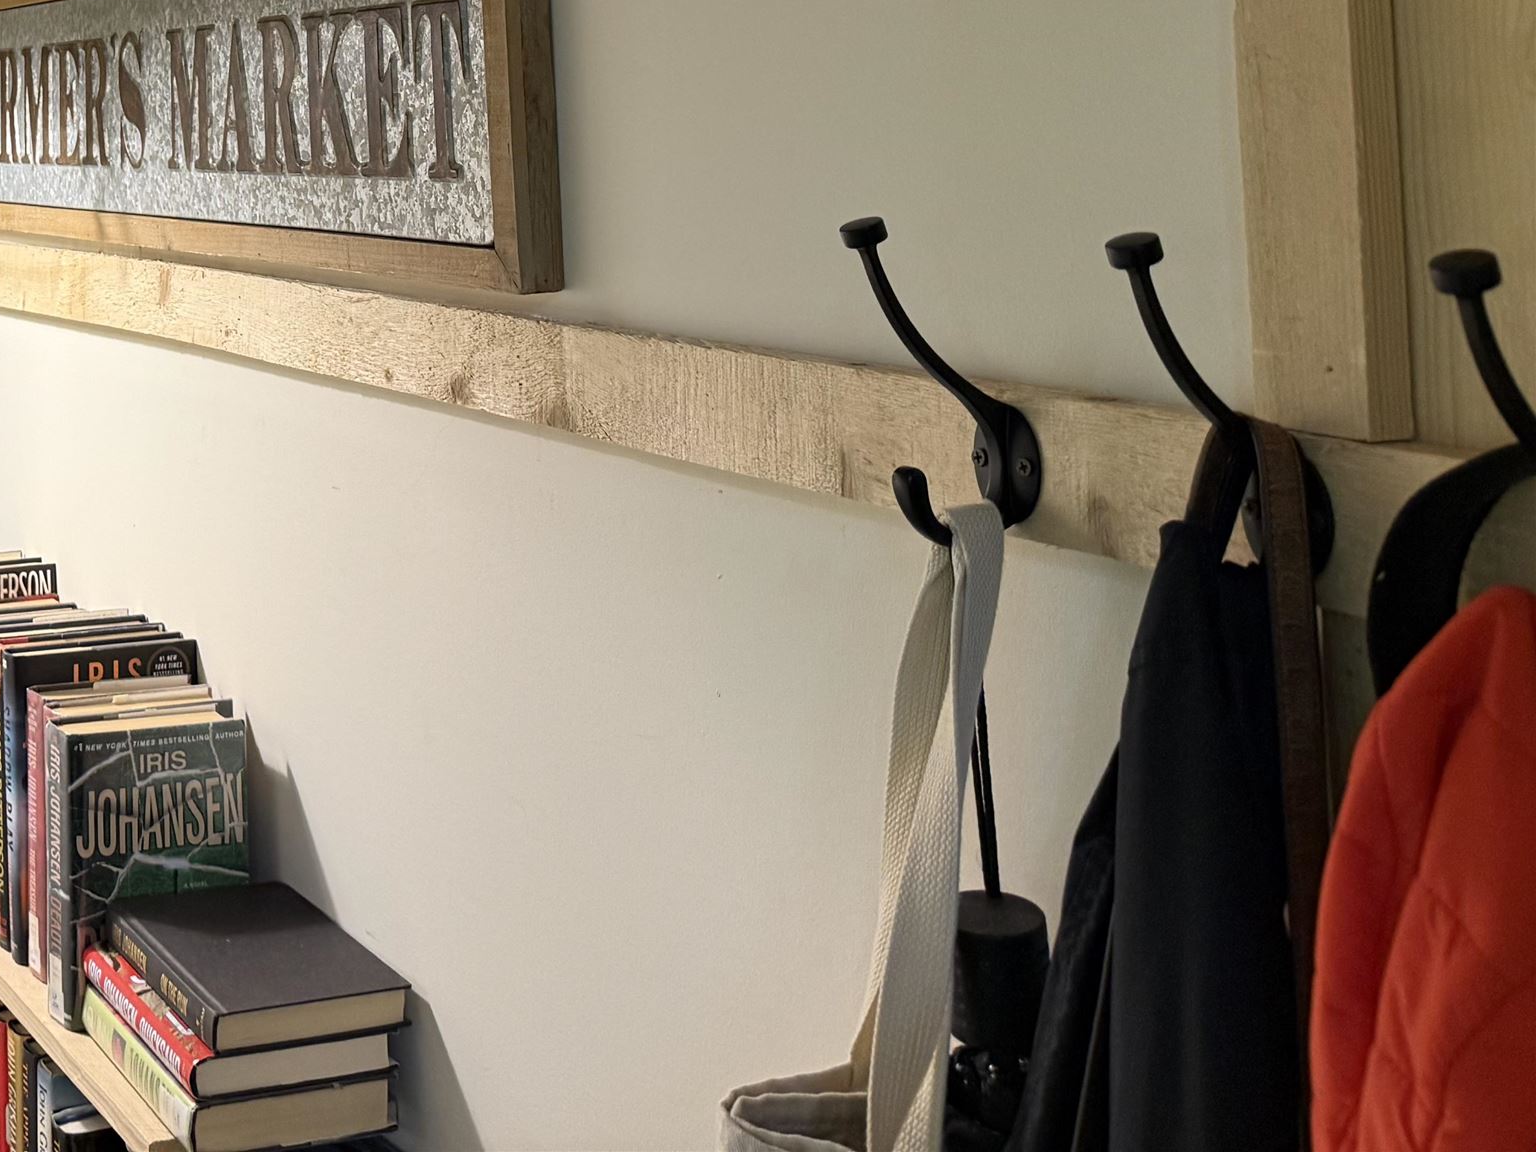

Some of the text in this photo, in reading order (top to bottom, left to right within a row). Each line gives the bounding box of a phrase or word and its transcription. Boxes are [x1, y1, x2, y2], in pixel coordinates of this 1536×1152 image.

[73, 658, 142, 685] IRIS
[27, 738, 37, 769] IRIS
[85, 743, 103, 752] NEW
[106, 740, 127, 750] YORK
[133, 738, 156, 748] TIMES
[158, 733, 210, 747] BESTSELLING
[215, 729, 245, 740] AUTHOR
[139, 750, 187, 774] IRIS
[50, 744, 62, 887] IRIS JOHANSEN
[76, 772, 244, 859] JOHANSEN
[50, 898, 62, 959] DEADL
[86, 959, 102, 987] IRIS
[103, 975, 138, 1029] JOHANSEN
[138, 1018, 182, 1072] QUICKSAND
[39, 1082, 48, 1128] JOHN
